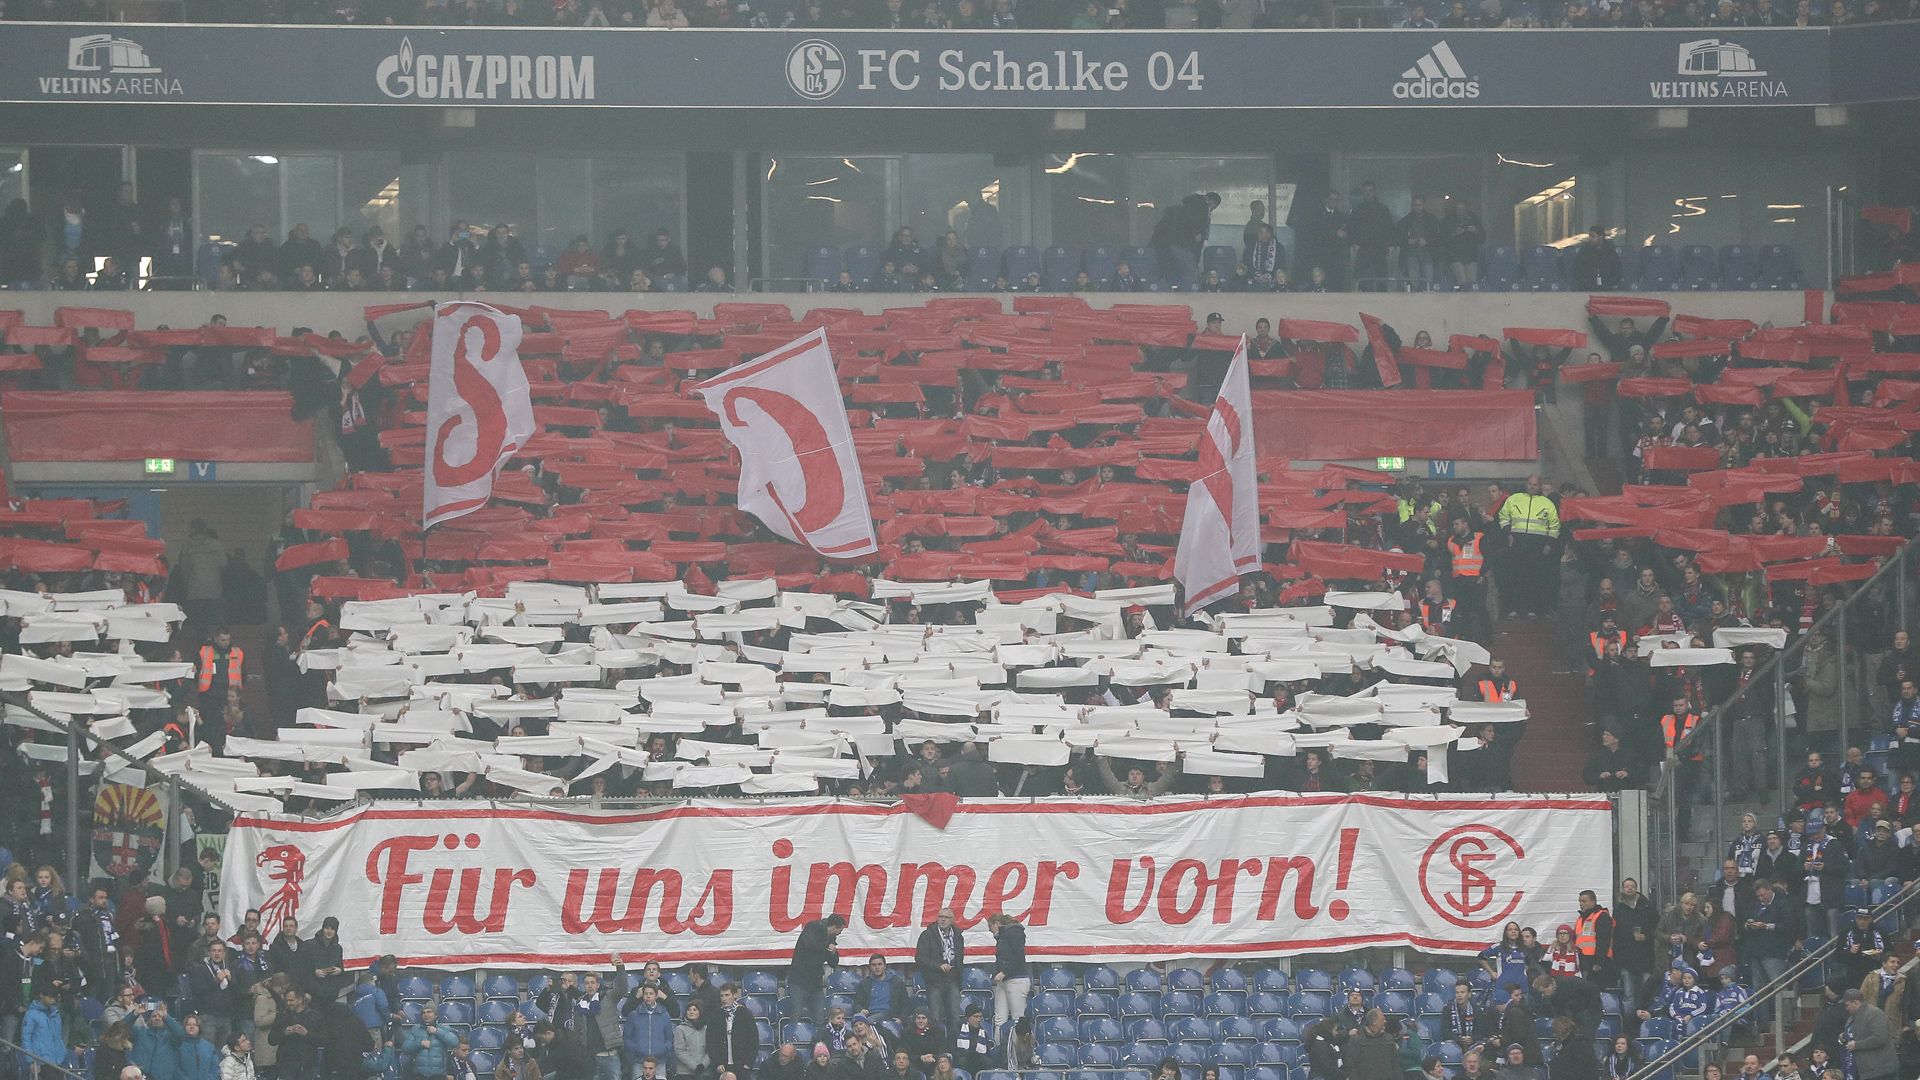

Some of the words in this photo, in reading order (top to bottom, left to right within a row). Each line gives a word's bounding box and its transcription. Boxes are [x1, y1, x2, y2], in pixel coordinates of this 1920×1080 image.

[416, 54, 595, 99] GAZPROM
[858, 49, 920, 91] FC
[938, 49, 1128, 91] Schalke
[1147, 50, 1204, 91] 04
[39, 77, 111, 94] VELTINS
[115, 78, 184, 95] ARENA
[1392, 76, 1480, 99] adidas
[1649, 81, 1719, 98] VELTINS
[1723, 81, 1788, 97] ARENA
[195, 462, 210, 476] V
[1433, 460, 1449, 474] W
[366, 833, 537, 935] Für
[561, 867, 734, 936] uns
[769, 838, 1080, 933] immer
[1105, 827, 1361, 924] vorn!
